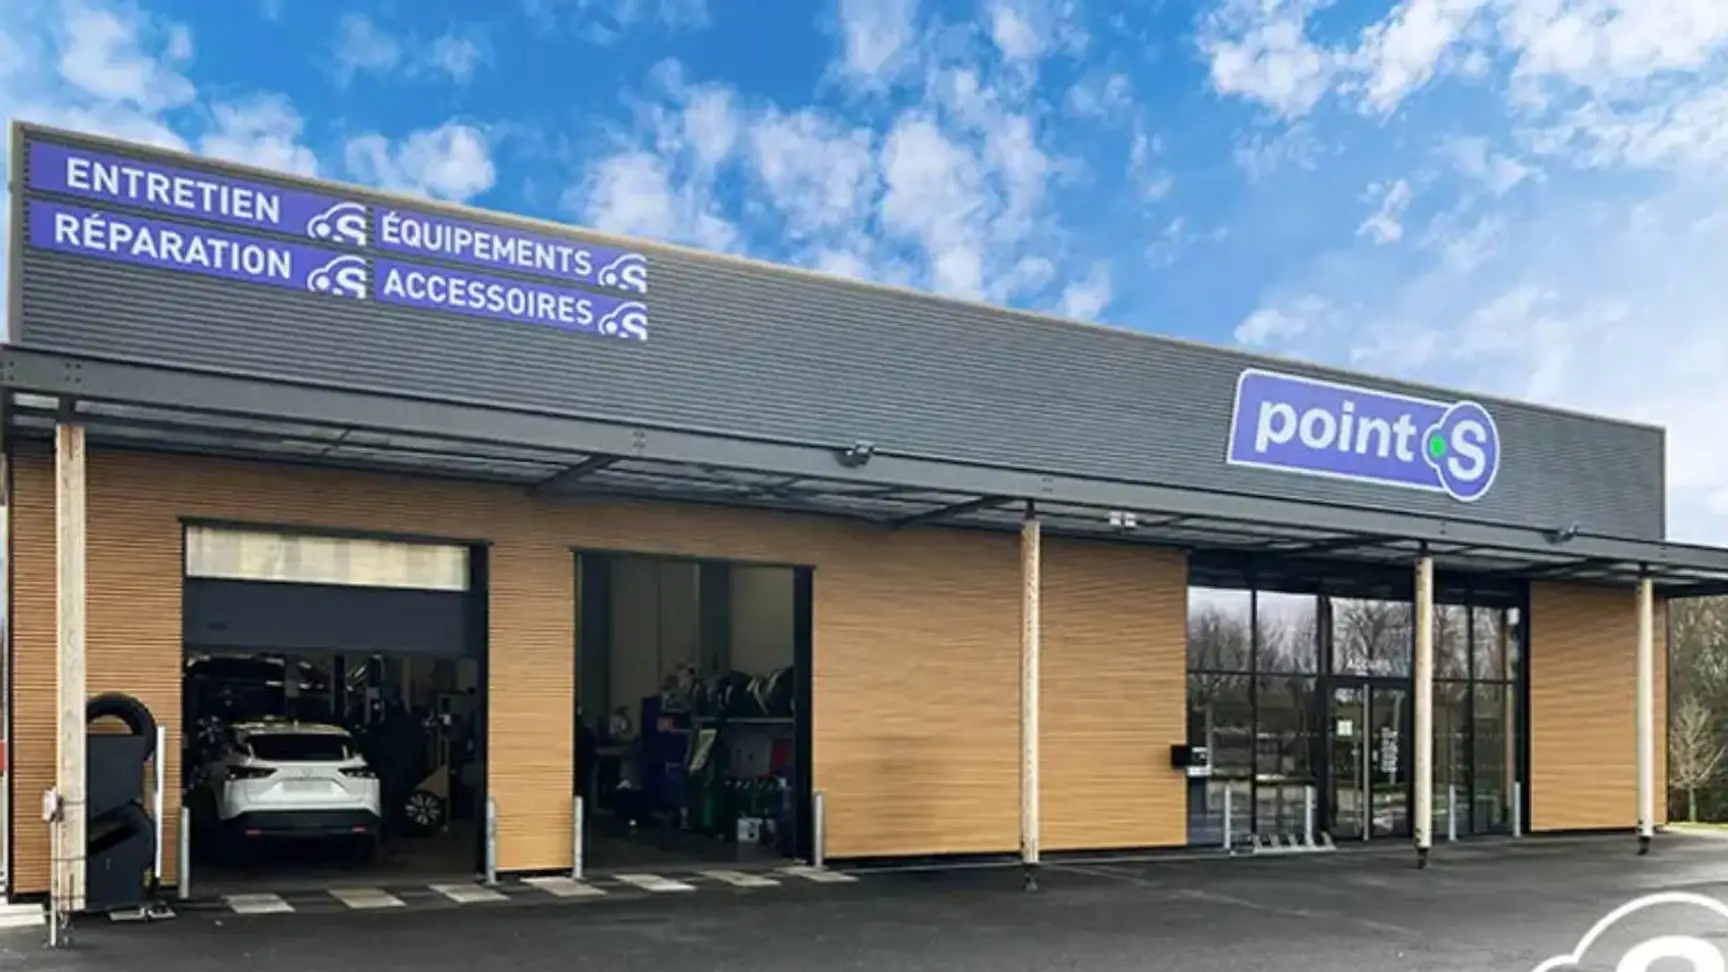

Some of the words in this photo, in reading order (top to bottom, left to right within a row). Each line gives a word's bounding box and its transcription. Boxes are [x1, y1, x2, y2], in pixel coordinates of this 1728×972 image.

[66, 157, 280, 224] ENTRETIEN
[54, 212, 291, 280] RÉPARATION
[381, 210, 593, 277] ÉQUIPEMENTS
[383, 268, 594, 326] ACCESSOIRES
[1254, 400, 1417, 462] point
